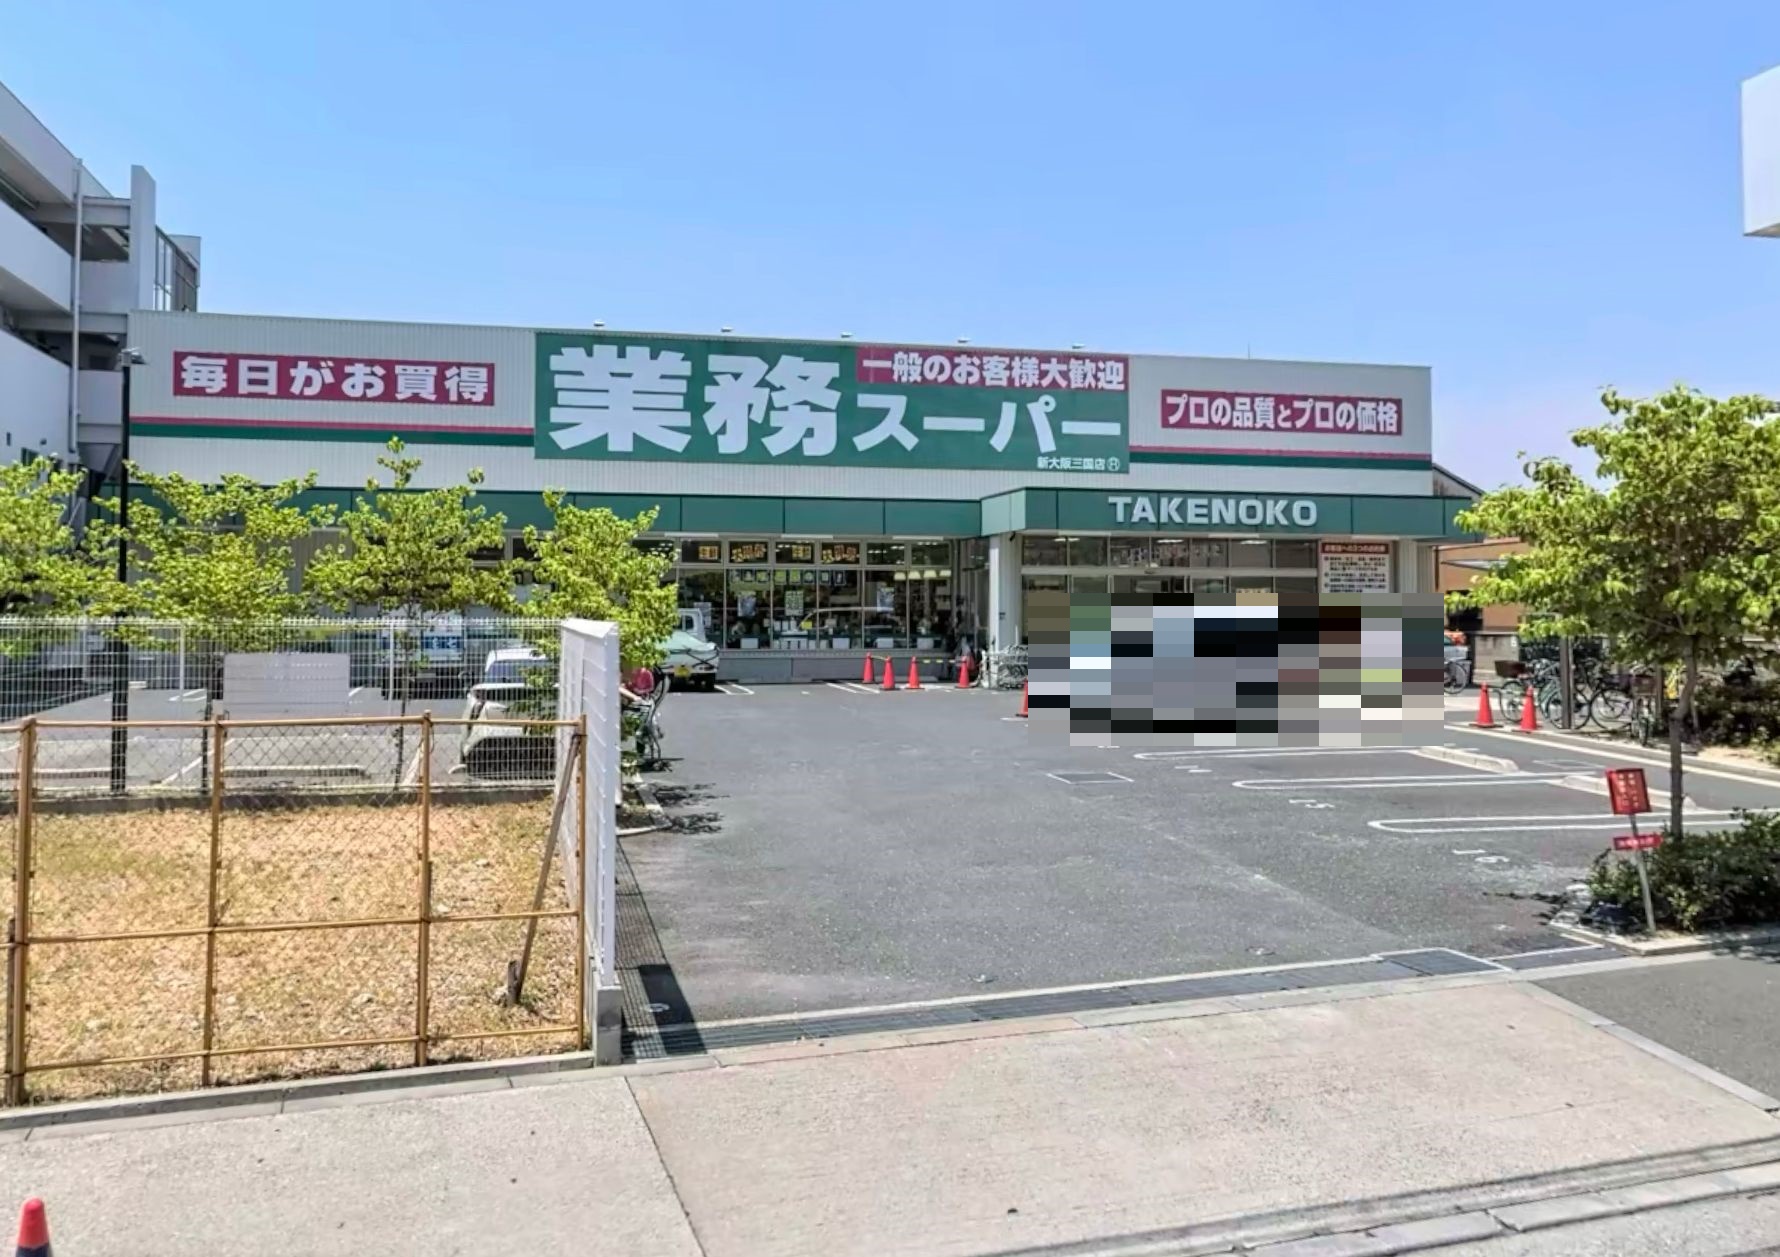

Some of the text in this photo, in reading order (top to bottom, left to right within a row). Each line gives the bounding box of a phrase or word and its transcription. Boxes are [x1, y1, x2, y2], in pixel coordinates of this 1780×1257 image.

[180, 355, 489, 404] 毎日がお買得
[863, 351, 1125, 391] 一般のお客様大歓迎
[549, 344, 1121, 457] 業務スーパー
[1166, 394, 1398, 433] プロの品質とプロの価格
[1108, 495, 1318, 527] TAKENOKO
